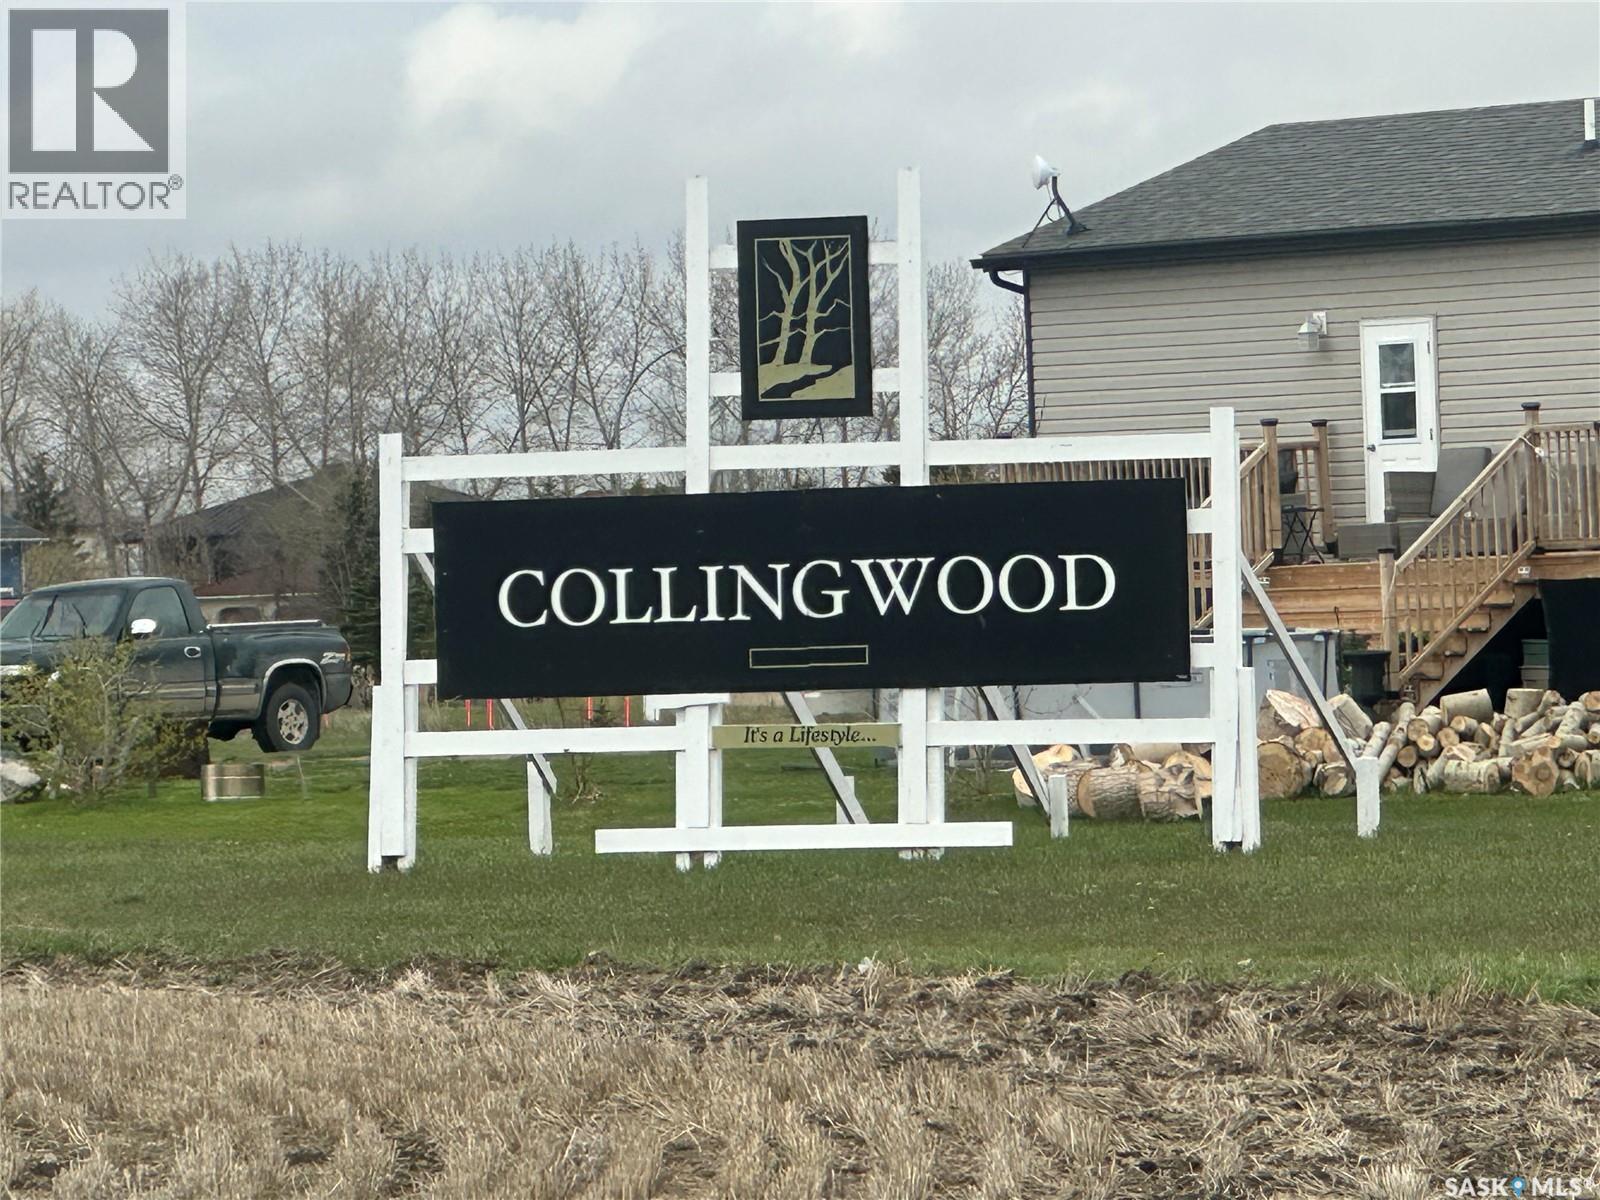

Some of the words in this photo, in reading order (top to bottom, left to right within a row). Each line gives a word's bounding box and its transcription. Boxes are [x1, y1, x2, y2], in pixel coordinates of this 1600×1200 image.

[497, 553, 1117, 627] COLLINGWOOD
[744, 725, 768, 743] It's
[773, 729, 784, 742] a
[789, 725, 877, 746] Lifestyle...
